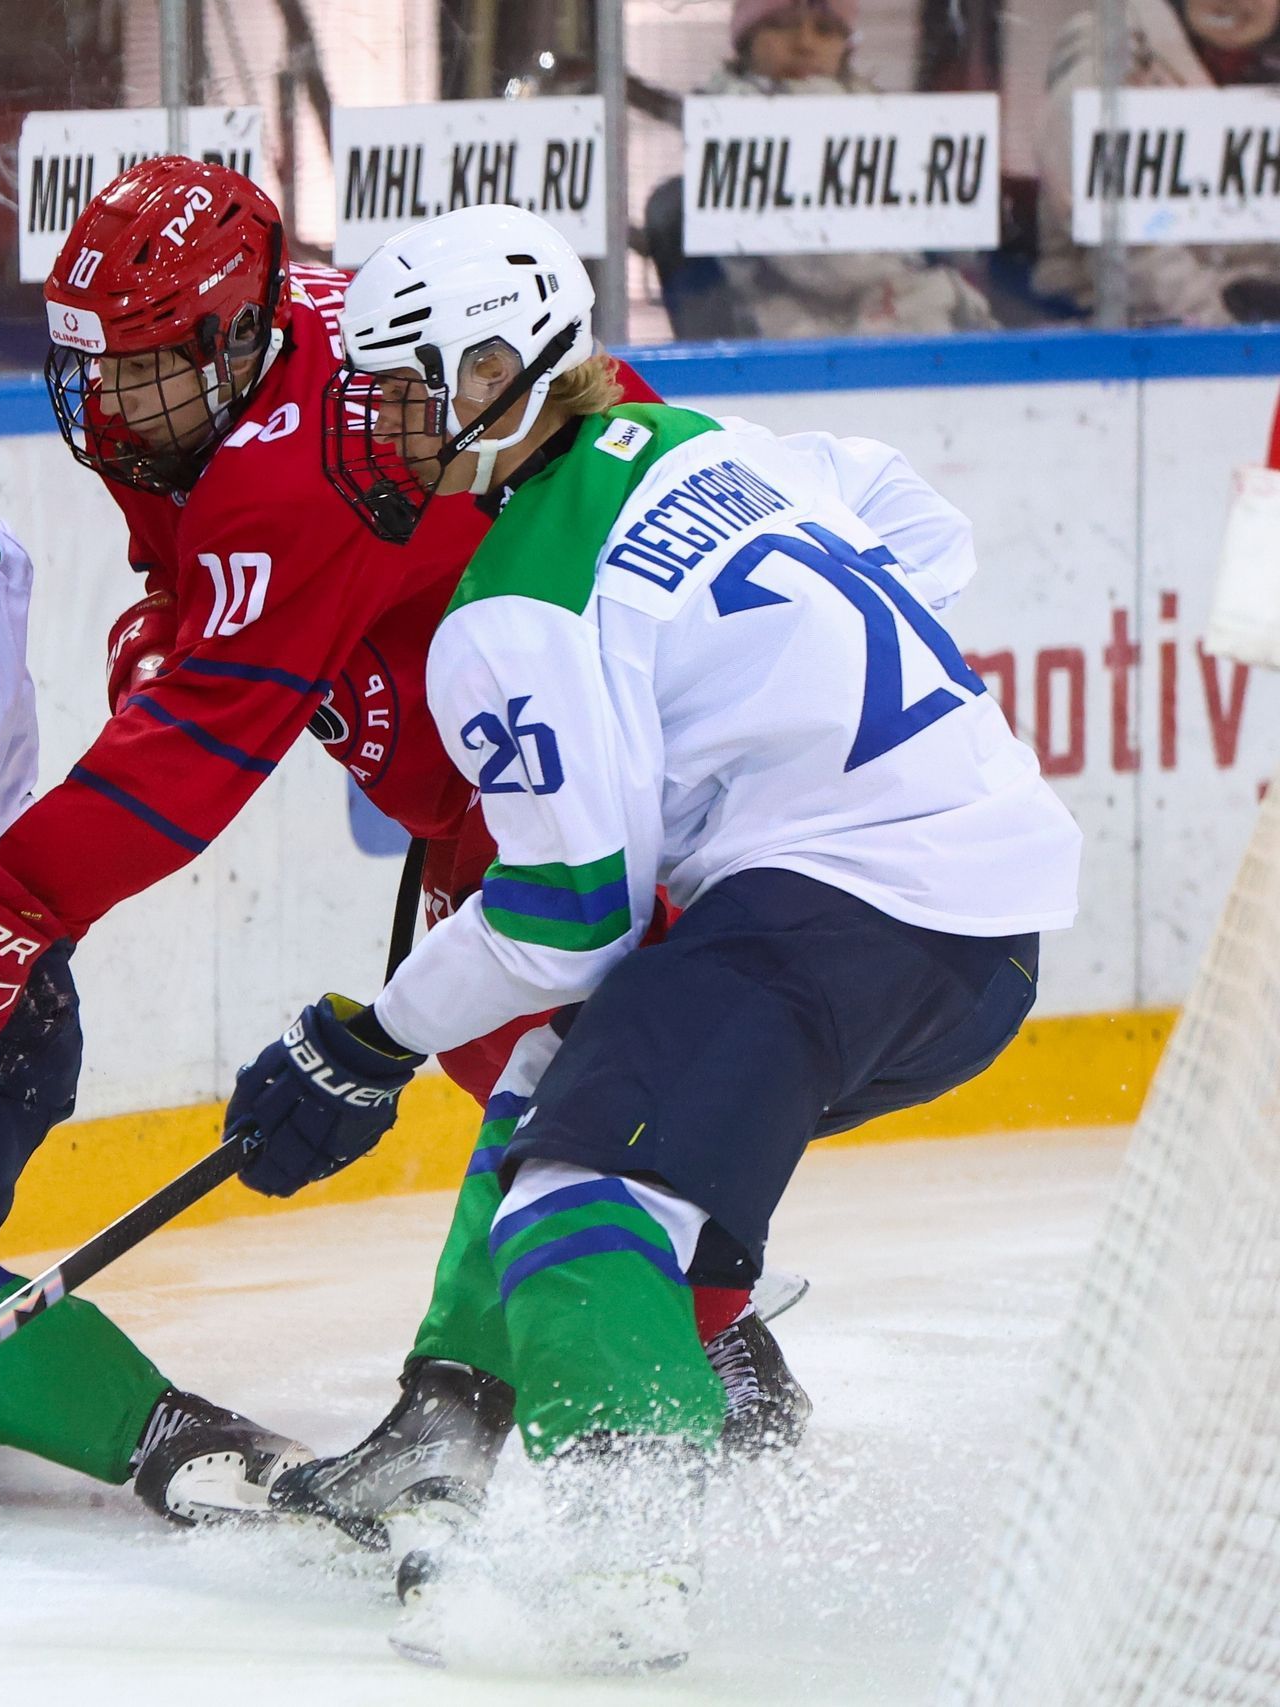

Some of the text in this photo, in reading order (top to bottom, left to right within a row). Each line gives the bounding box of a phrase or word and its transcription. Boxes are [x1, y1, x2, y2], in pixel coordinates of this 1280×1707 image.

[345, 139, 594, 220] MHL.KHL.RU
[697, 135, 988, 212] MHL.KHL.RU
[67, 247, 104, 289] 10
[198, 252, 244, 296] BAUER
[465, 291, 520, 318] CCM
[52, 329, 100, 349] OLIMPBET
[455, 423, 485, 451] CCM
[197, 551, 272, 639] 10
[460, 694, 565, 795] 26
[282, 1019, 404, 1107] BAUER
